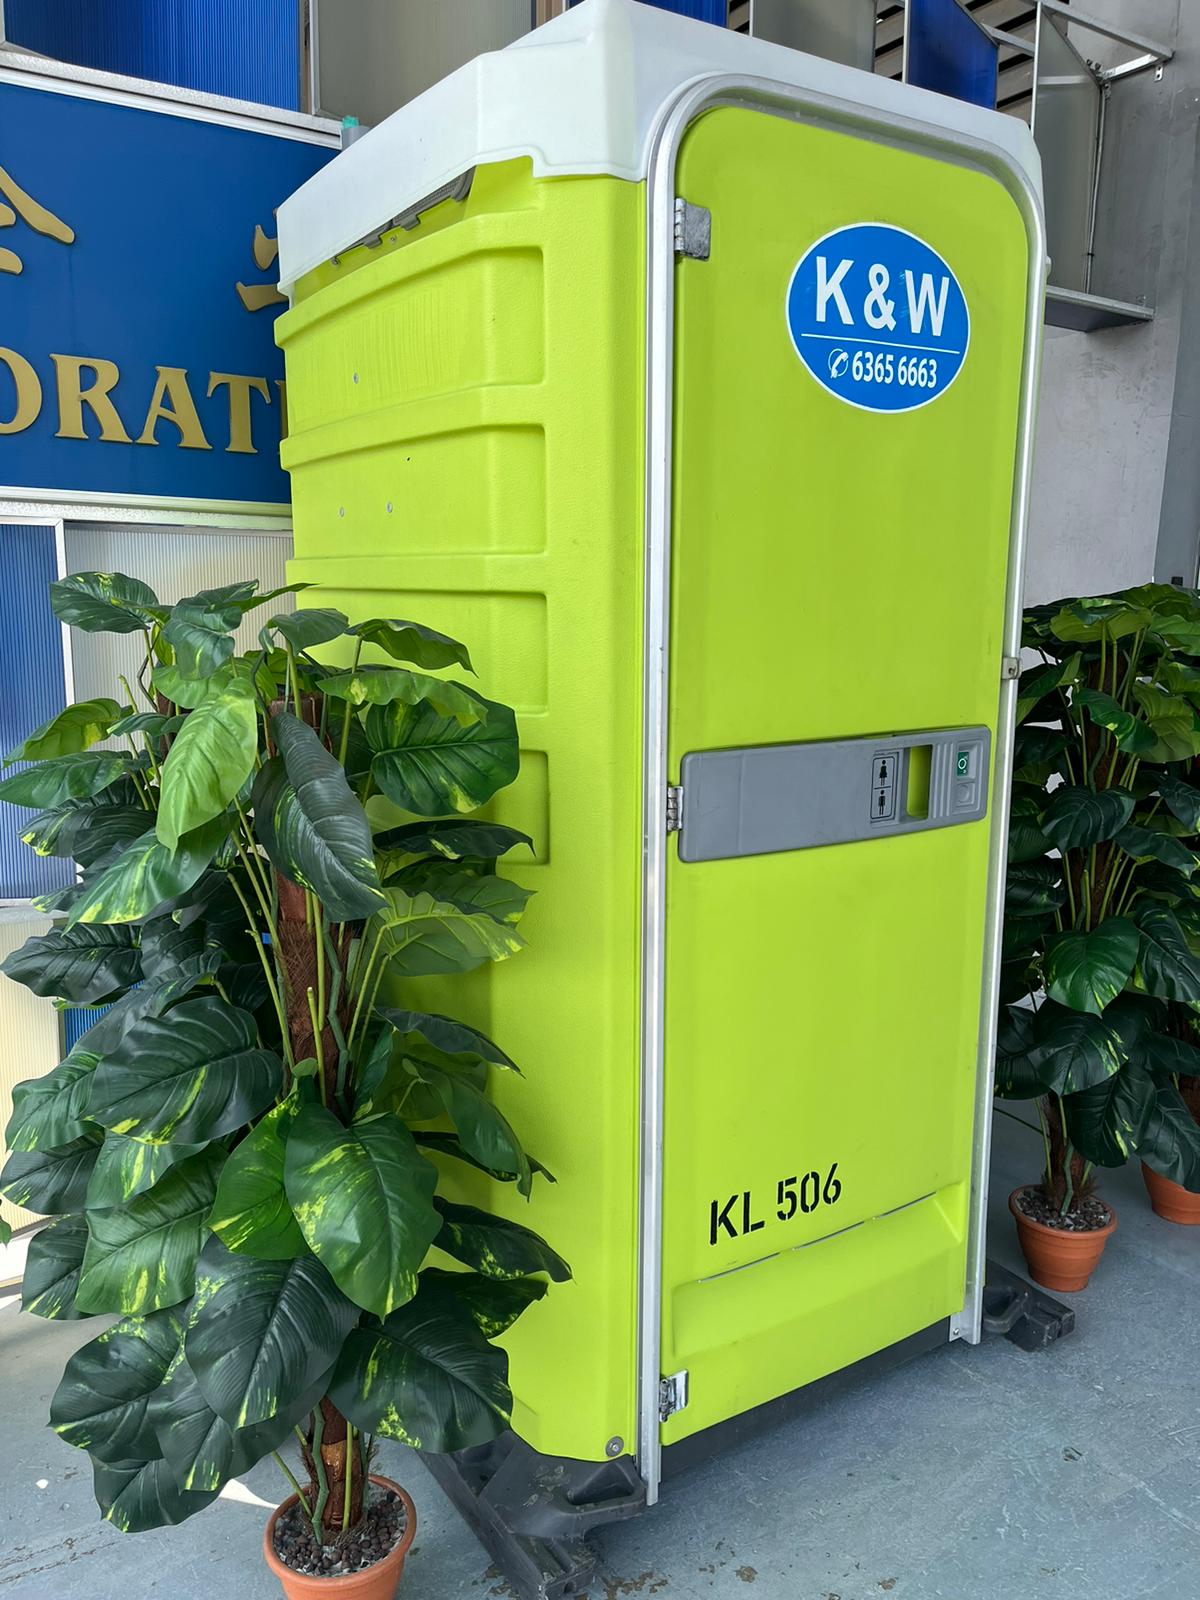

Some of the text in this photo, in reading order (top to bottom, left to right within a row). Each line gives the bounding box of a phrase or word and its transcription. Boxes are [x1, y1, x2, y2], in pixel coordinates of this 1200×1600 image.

[816, 255, 950, 337] K & W
[709, 1162, 842, 1246] KL 506
